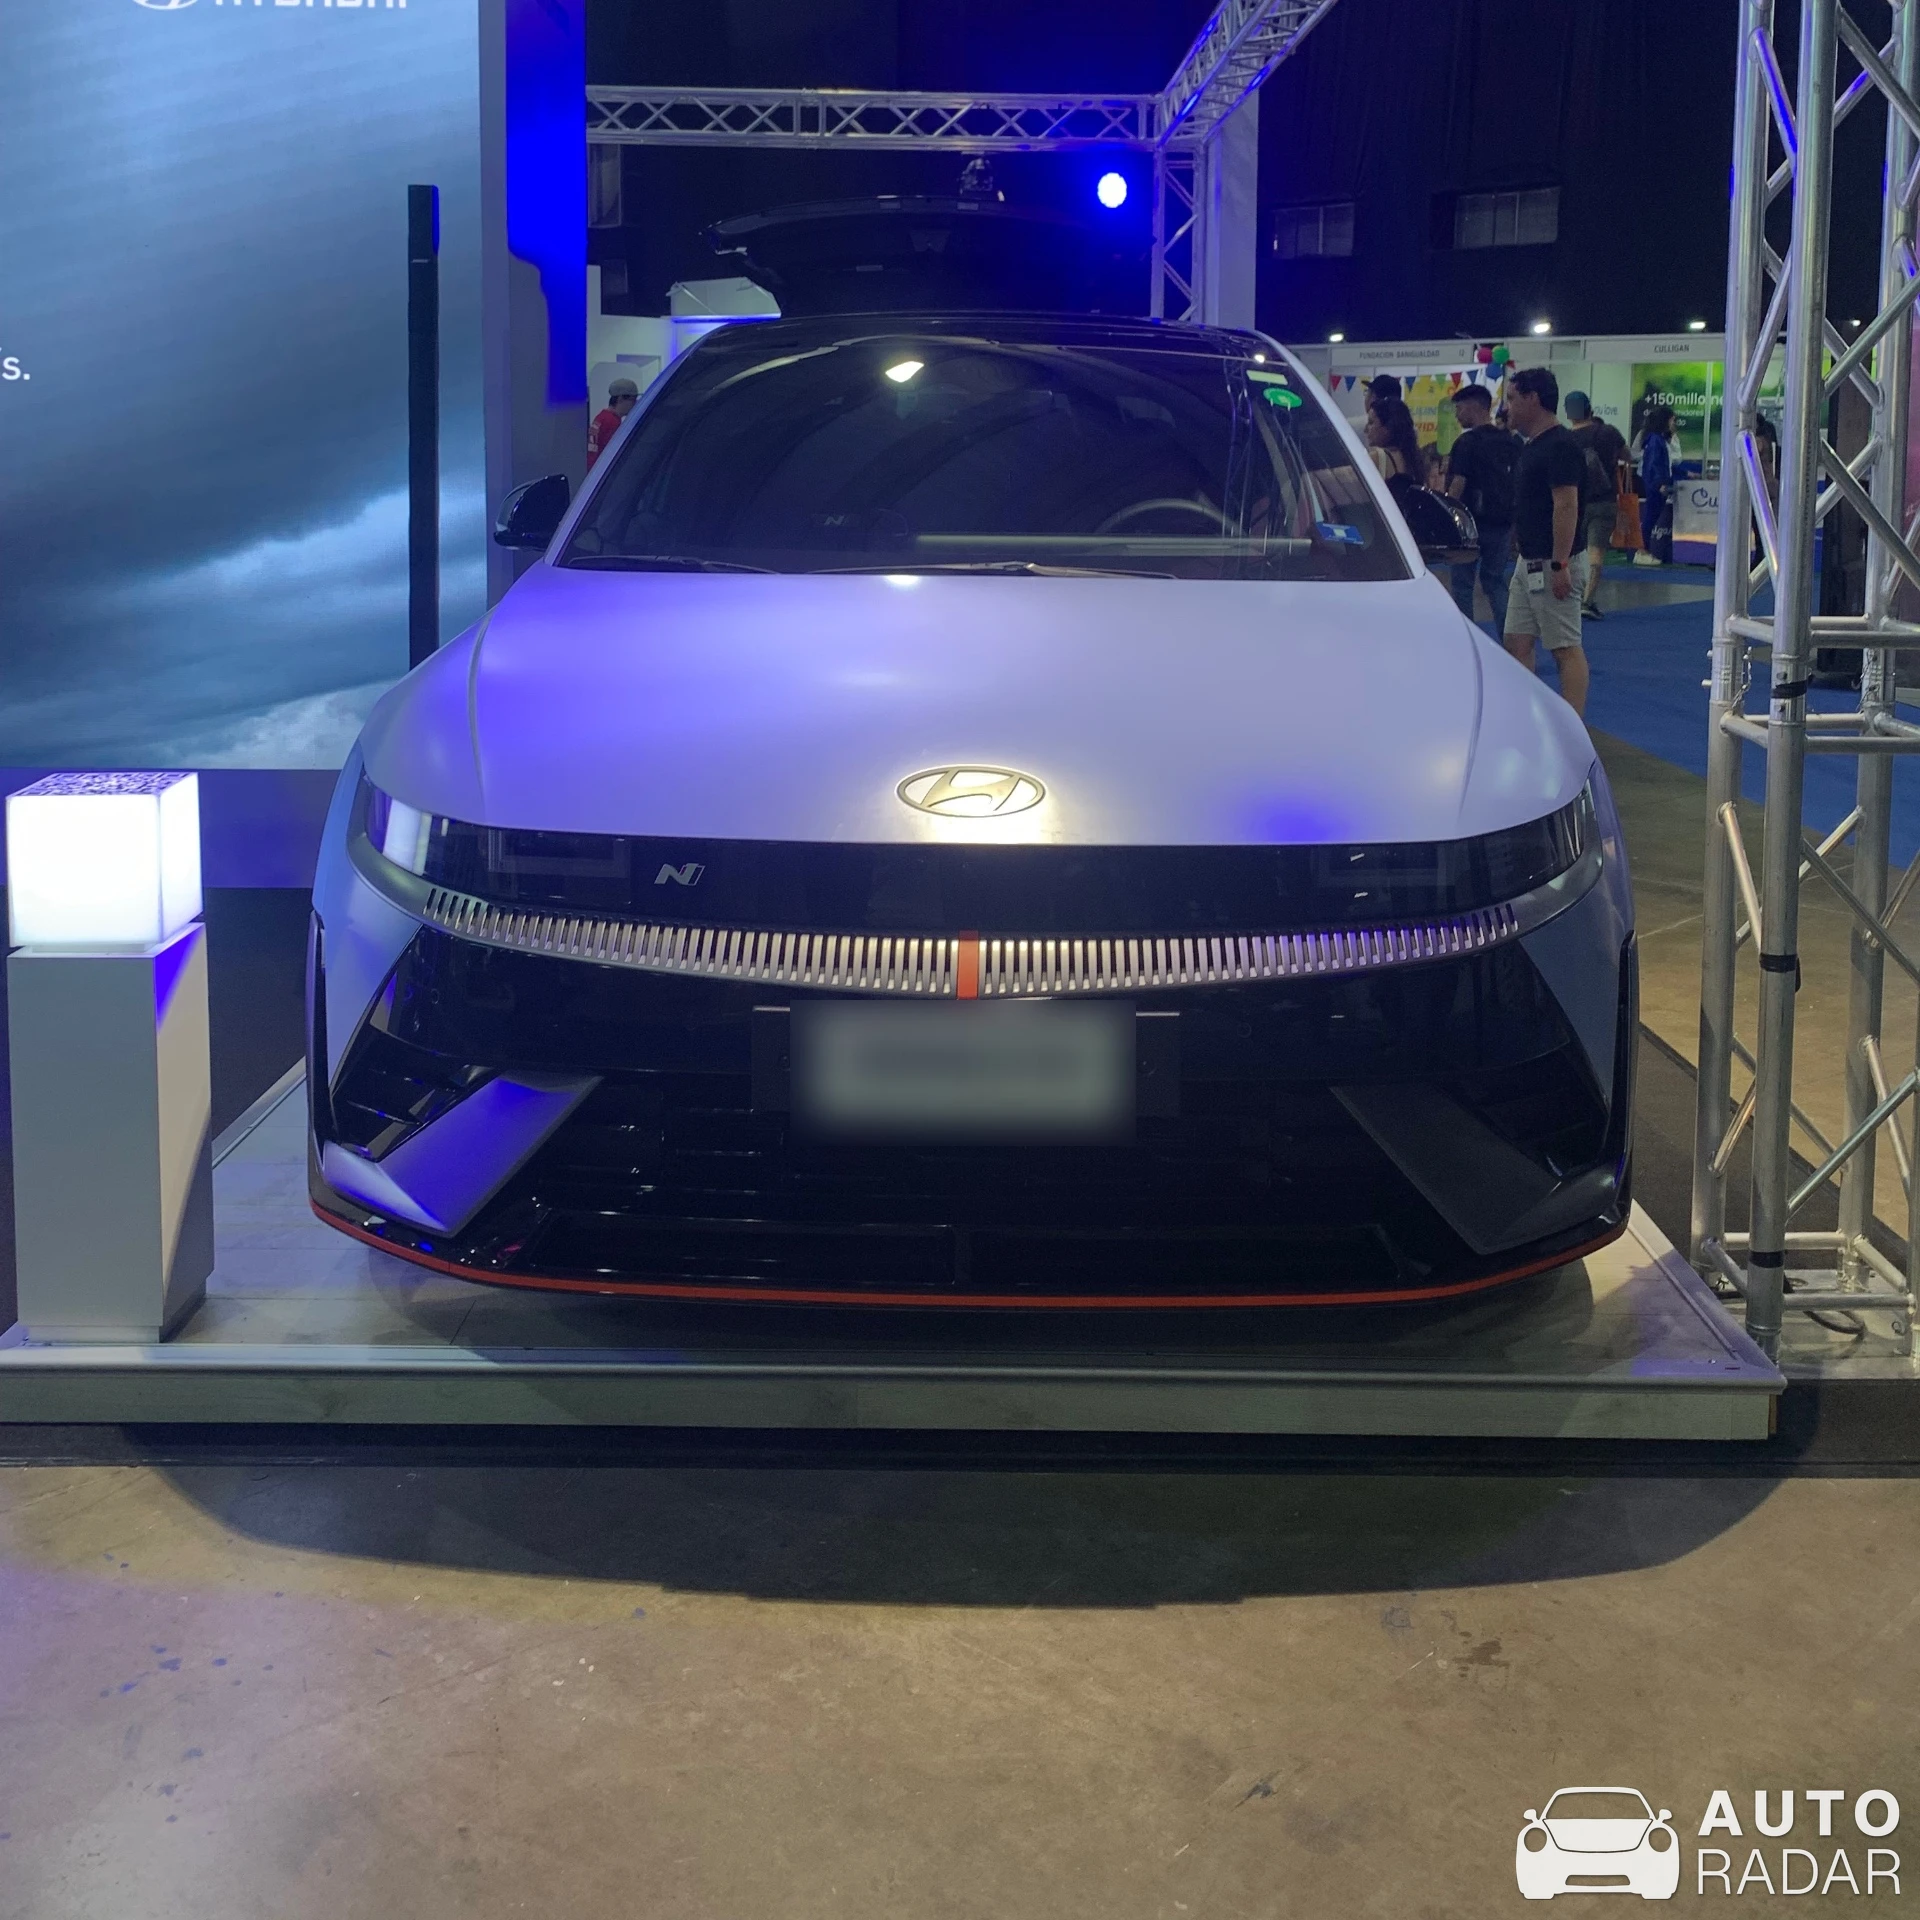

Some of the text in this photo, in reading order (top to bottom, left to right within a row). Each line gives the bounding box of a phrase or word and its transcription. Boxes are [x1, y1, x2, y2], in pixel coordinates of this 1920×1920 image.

[1653, 344, 1690, 353] CULLIGAN
[1359, 351, 1394, 360] FUNDACION
[0, 346, 31, 381] s.
